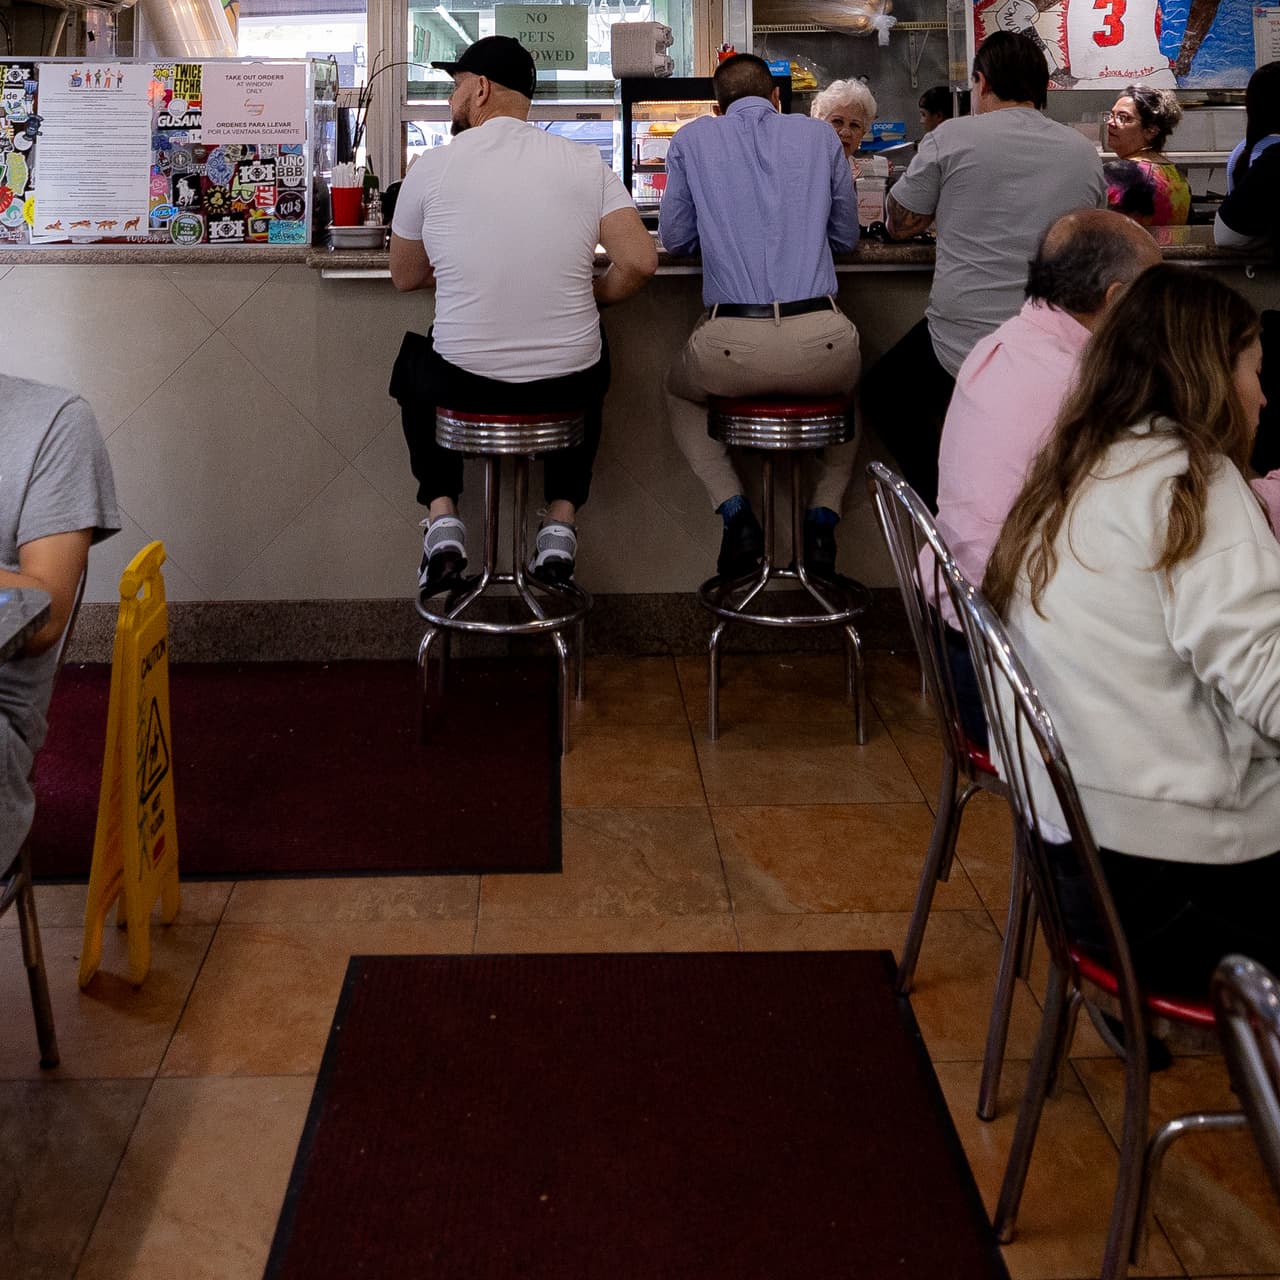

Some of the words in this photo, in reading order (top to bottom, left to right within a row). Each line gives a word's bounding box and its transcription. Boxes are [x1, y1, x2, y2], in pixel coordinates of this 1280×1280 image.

[526, 13, 547, 24] NO
[520, 32, 555, 43] PETS
[532, 50, 574, 62] OWED
[175, 64, 202, 78] TWICE
[174, 79, 200, 94] ETCHR
[874, 122, 894, 130] paper
[274, 156, 304, 166] YUNO
[277, 167, 304, 176] BBB
